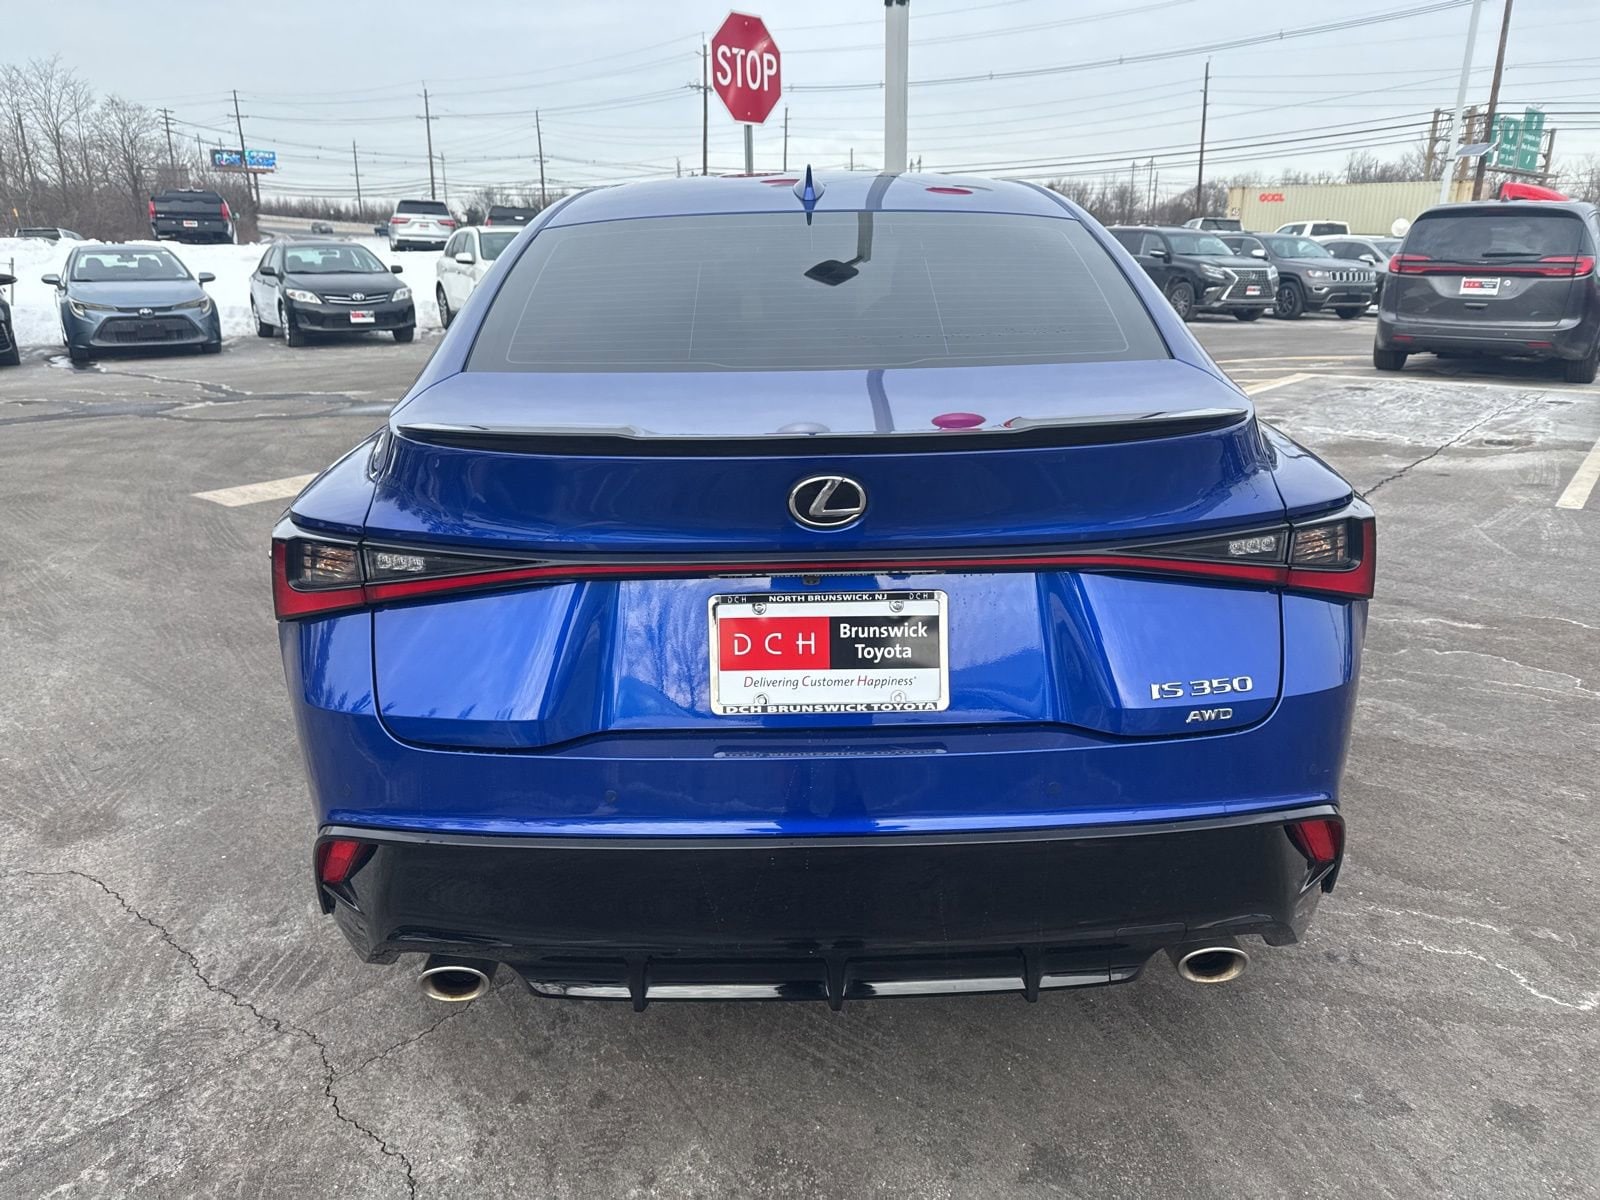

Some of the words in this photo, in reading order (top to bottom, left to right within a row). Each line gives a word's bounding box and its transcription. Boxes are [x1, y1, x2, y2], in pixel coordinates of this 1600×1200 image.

[716, 45, 777, 92] STOP
[807, 593, 872, 602] BRUNSWICK,
[839, 622, 927, 638] Brunswick
[854, 643, 912, 663] Toyota
[743, 676, 799, 690] Delivering
[801, 675, 855, 688] Customer
[1150, 682, 1184, 700] IS
[1189, 676, 1253, 696] 350
[725, 705, 762, 714] DCH
[767, 703, 868, 713] BRUNSWICK
[871, 702, 937, 712] TOYOTA
[1185, 708, 1233, 723] AWD
